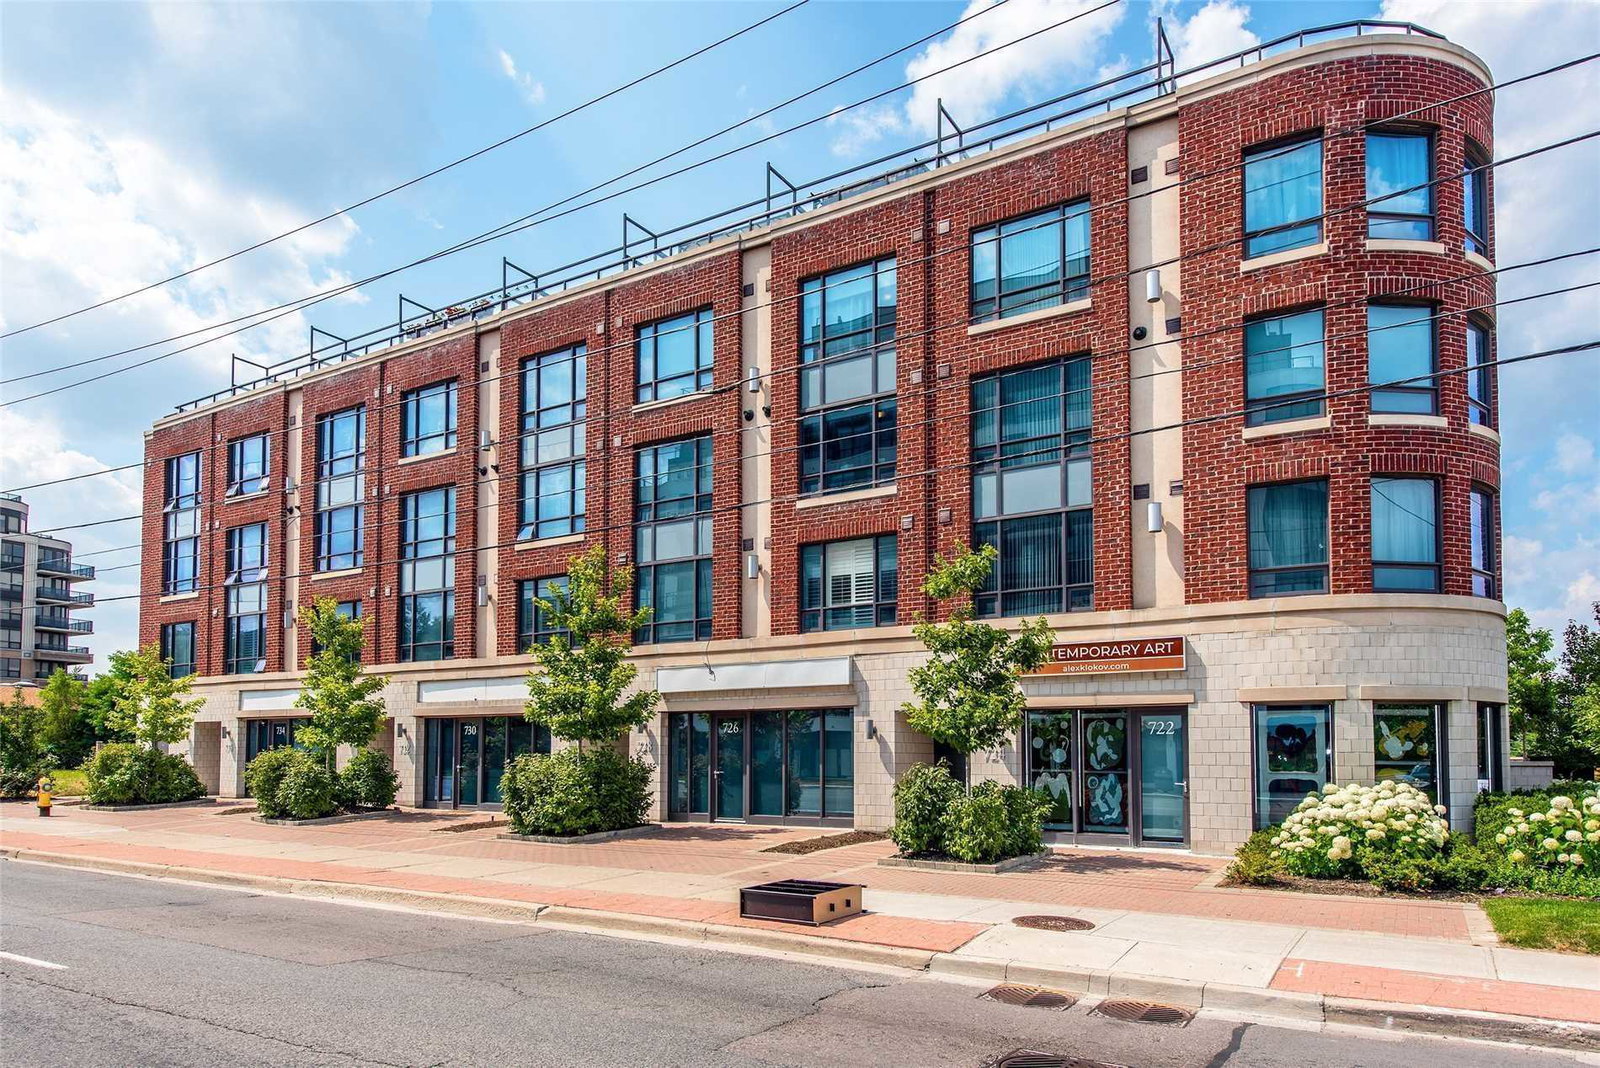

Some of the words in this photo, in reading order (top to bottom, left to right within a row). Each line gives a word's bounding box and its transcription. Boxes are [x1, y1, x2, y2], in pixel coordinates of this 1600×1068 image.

[1143, 641, 1174, 655] ART
[1062, 662, 1130, 673] alexklokov.com
[275, 726, 286, 735] 734
[464, 725, 477, 735] 730
[722, 721, 739, 734] 726
[1147, 721, 1175, 735] 722
